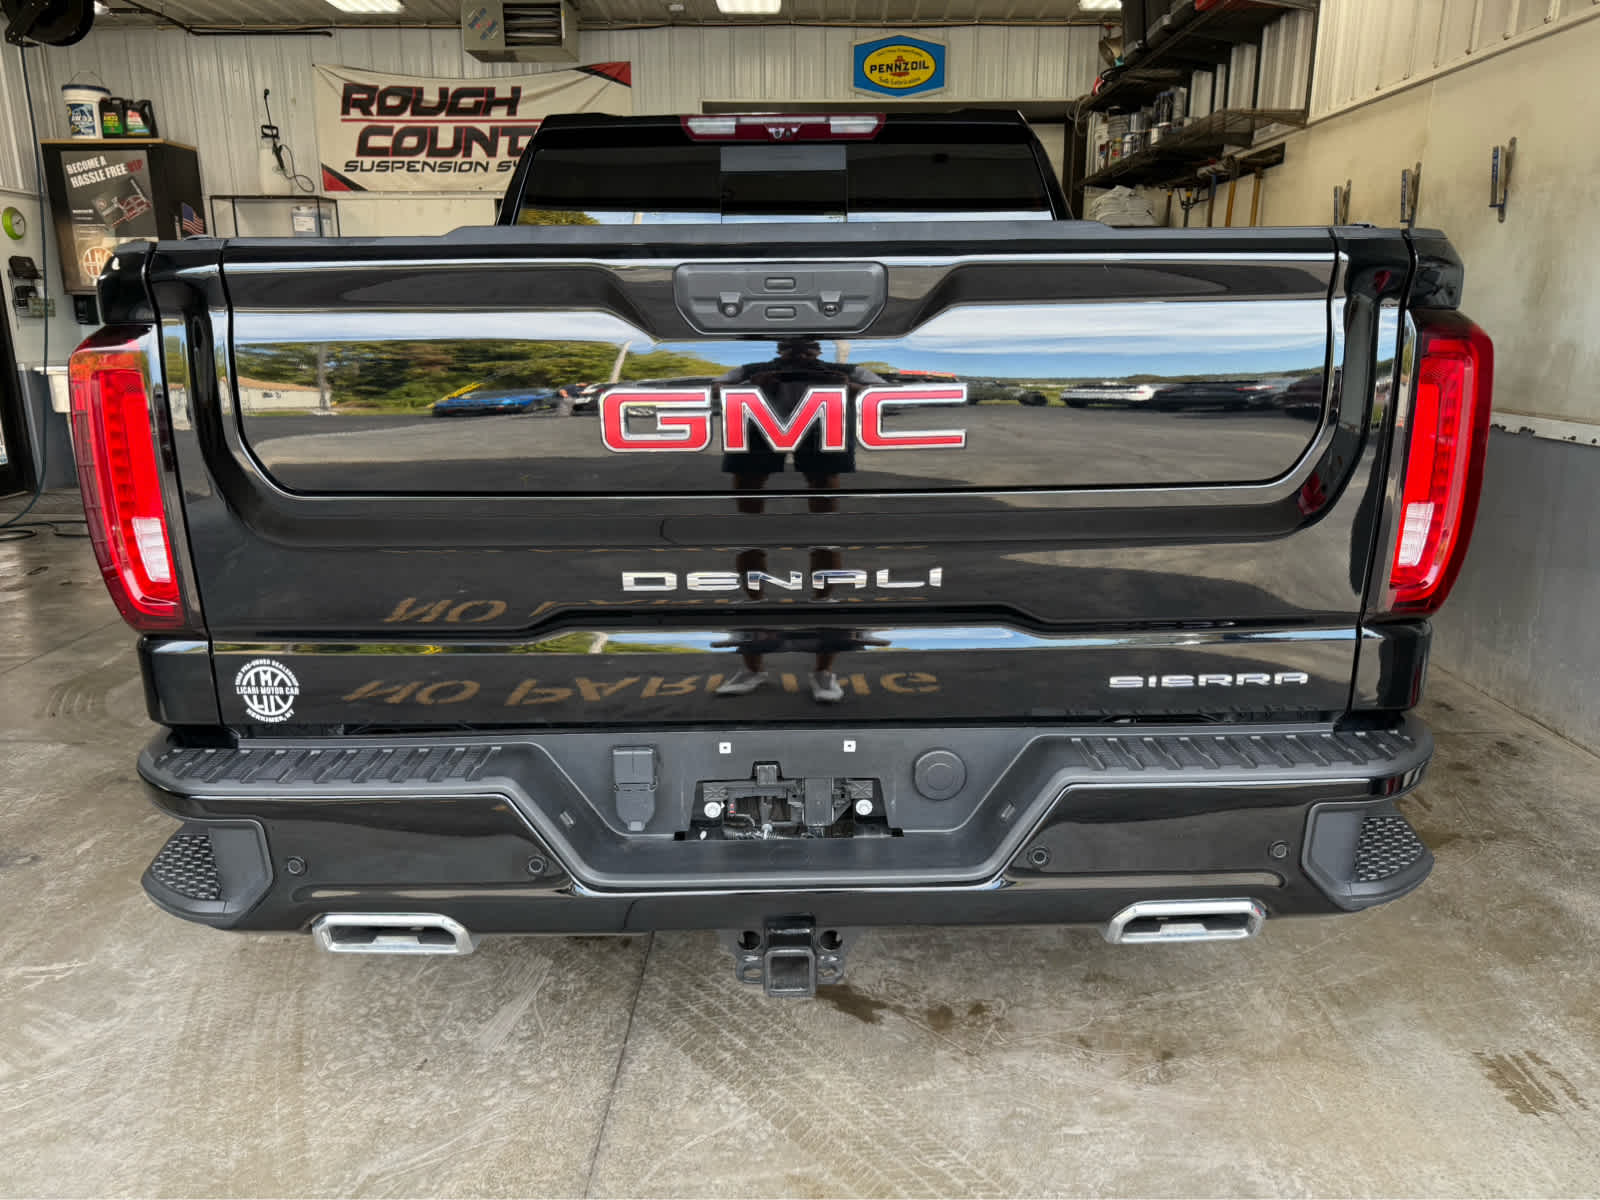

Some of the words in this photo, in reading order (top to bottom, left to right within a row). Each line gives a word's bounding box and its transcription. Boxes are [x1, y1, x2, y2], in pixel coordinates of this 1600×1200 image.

[869, 60, 930, 74] PENNZOIL
[340, 83, 522, 117] ROUGH
[66, 157, 100, 174] BECOME
[100, 156, 107, 166] A
[343, 159, 490, 173] SUSPENSION
[70, 169, 106, 188] HASSLE
[105, 163, 128, 179] FREE
[600, 383, 968, 454] GMC
[622, 566, 943, 592] DENALI
[1109, 671, 1309, 688] SIERRA
[235, 686, 259, 695] LICARI
[260, 686, 284, 695] MOTOR
[285, 686, 300, 695] CAR
